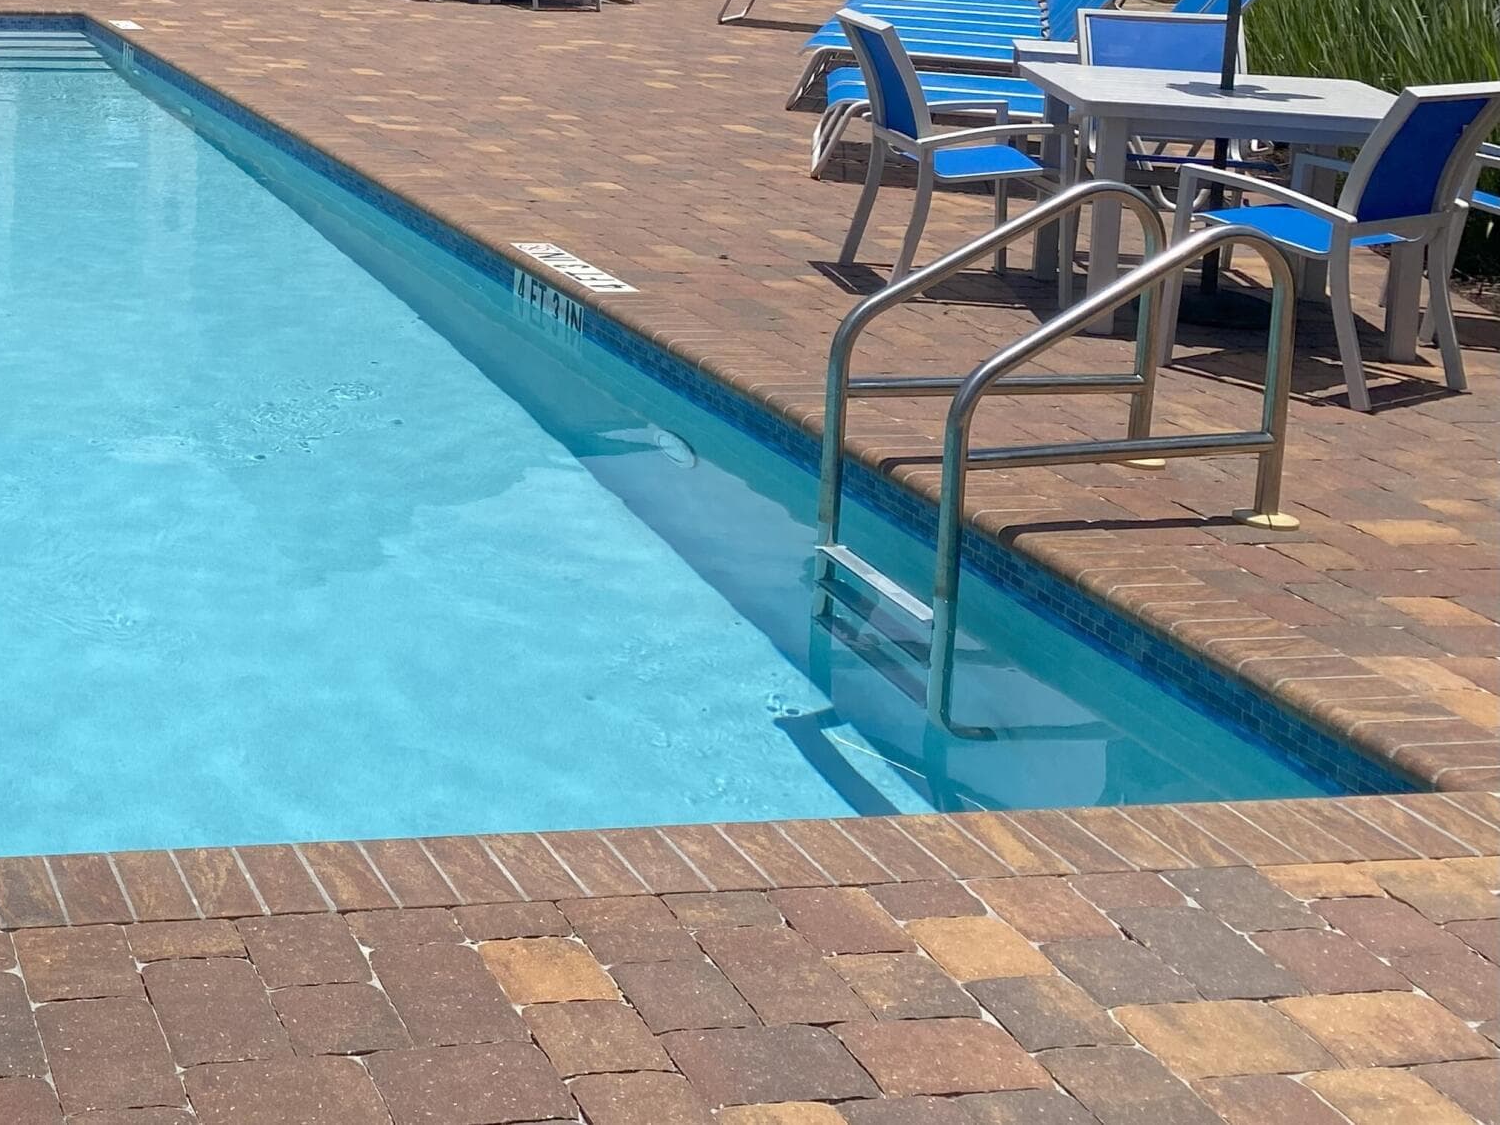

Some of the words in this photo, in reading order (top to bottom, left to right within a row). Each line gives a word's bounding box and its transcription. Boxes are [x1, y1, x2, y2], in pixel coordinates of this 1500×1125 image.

[517, 272, 525, 299] 4
[530, 278, 548, 311] FT
[552, 292, 560, 320] 3
[564, 299, 583, 333] IN
